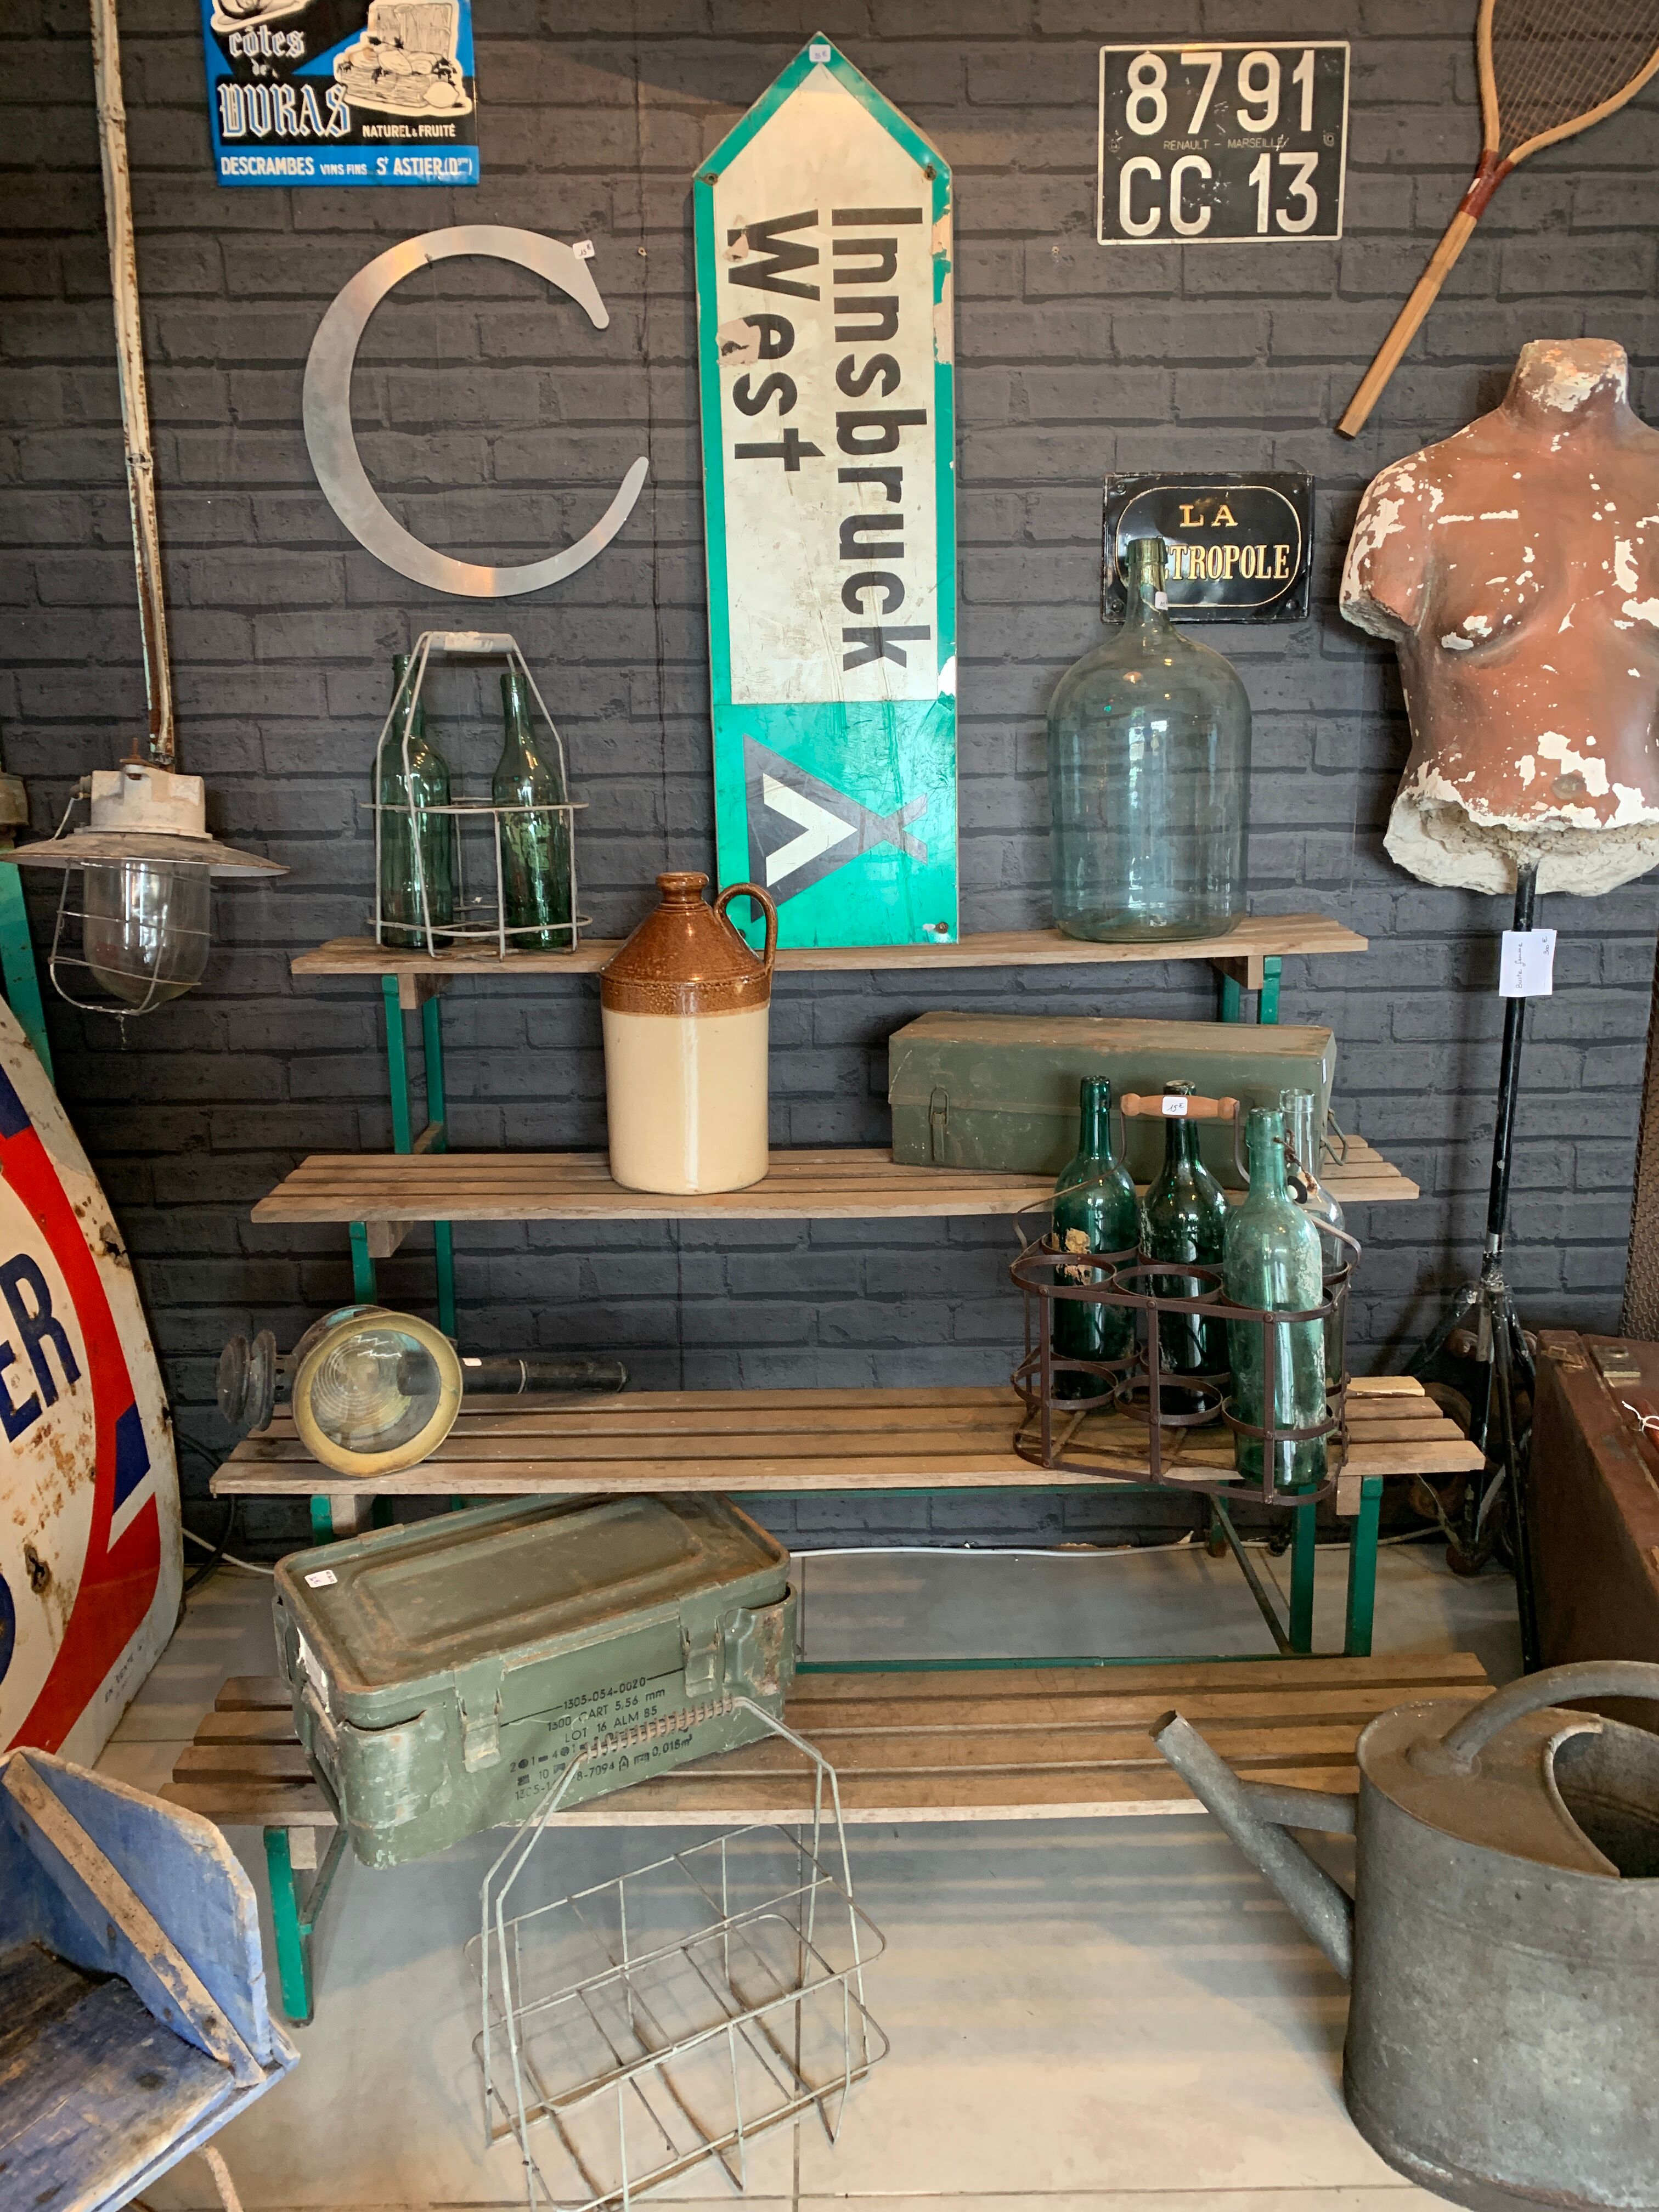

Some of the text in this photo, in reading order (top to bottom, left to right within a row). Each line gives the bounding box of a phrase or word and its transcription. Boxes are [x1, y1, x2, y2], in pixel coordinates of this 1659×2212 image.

[217, 83, 351, 137] DURAS
[1125, 49, 1314, 136] 8791
[1163, 138, 1210, 151] RENAULT
[1227, 137, 1286, 150] MARSEILLE
[221, 157, 314, 176] DESCRAMBES
[320, 164, 345, 175] VINS
[346, 163, 368, 175] FINS
[393, 157, 442, 176] ASTIER
[1119, 151, 1318, 236] CC 13
[725, 209, 826, 471] West
[832, 207, 931, 672] Innsbruck
[1178, 504, 1238, 527] LA
[1165, 544, 1290, 580] TROPOLE
[548, 1716, 572, 1731] 1300
[579, 1704, 609, 1722] CART
[645, 1688, 665, 1701] mm
[563, 1677, 646, 1710] 1305-054-0020
[565, 1727, 588, 1743] LOT
[597, 1722, 607, 1733] 16
[614, 1711, 639, 1728] ALM
